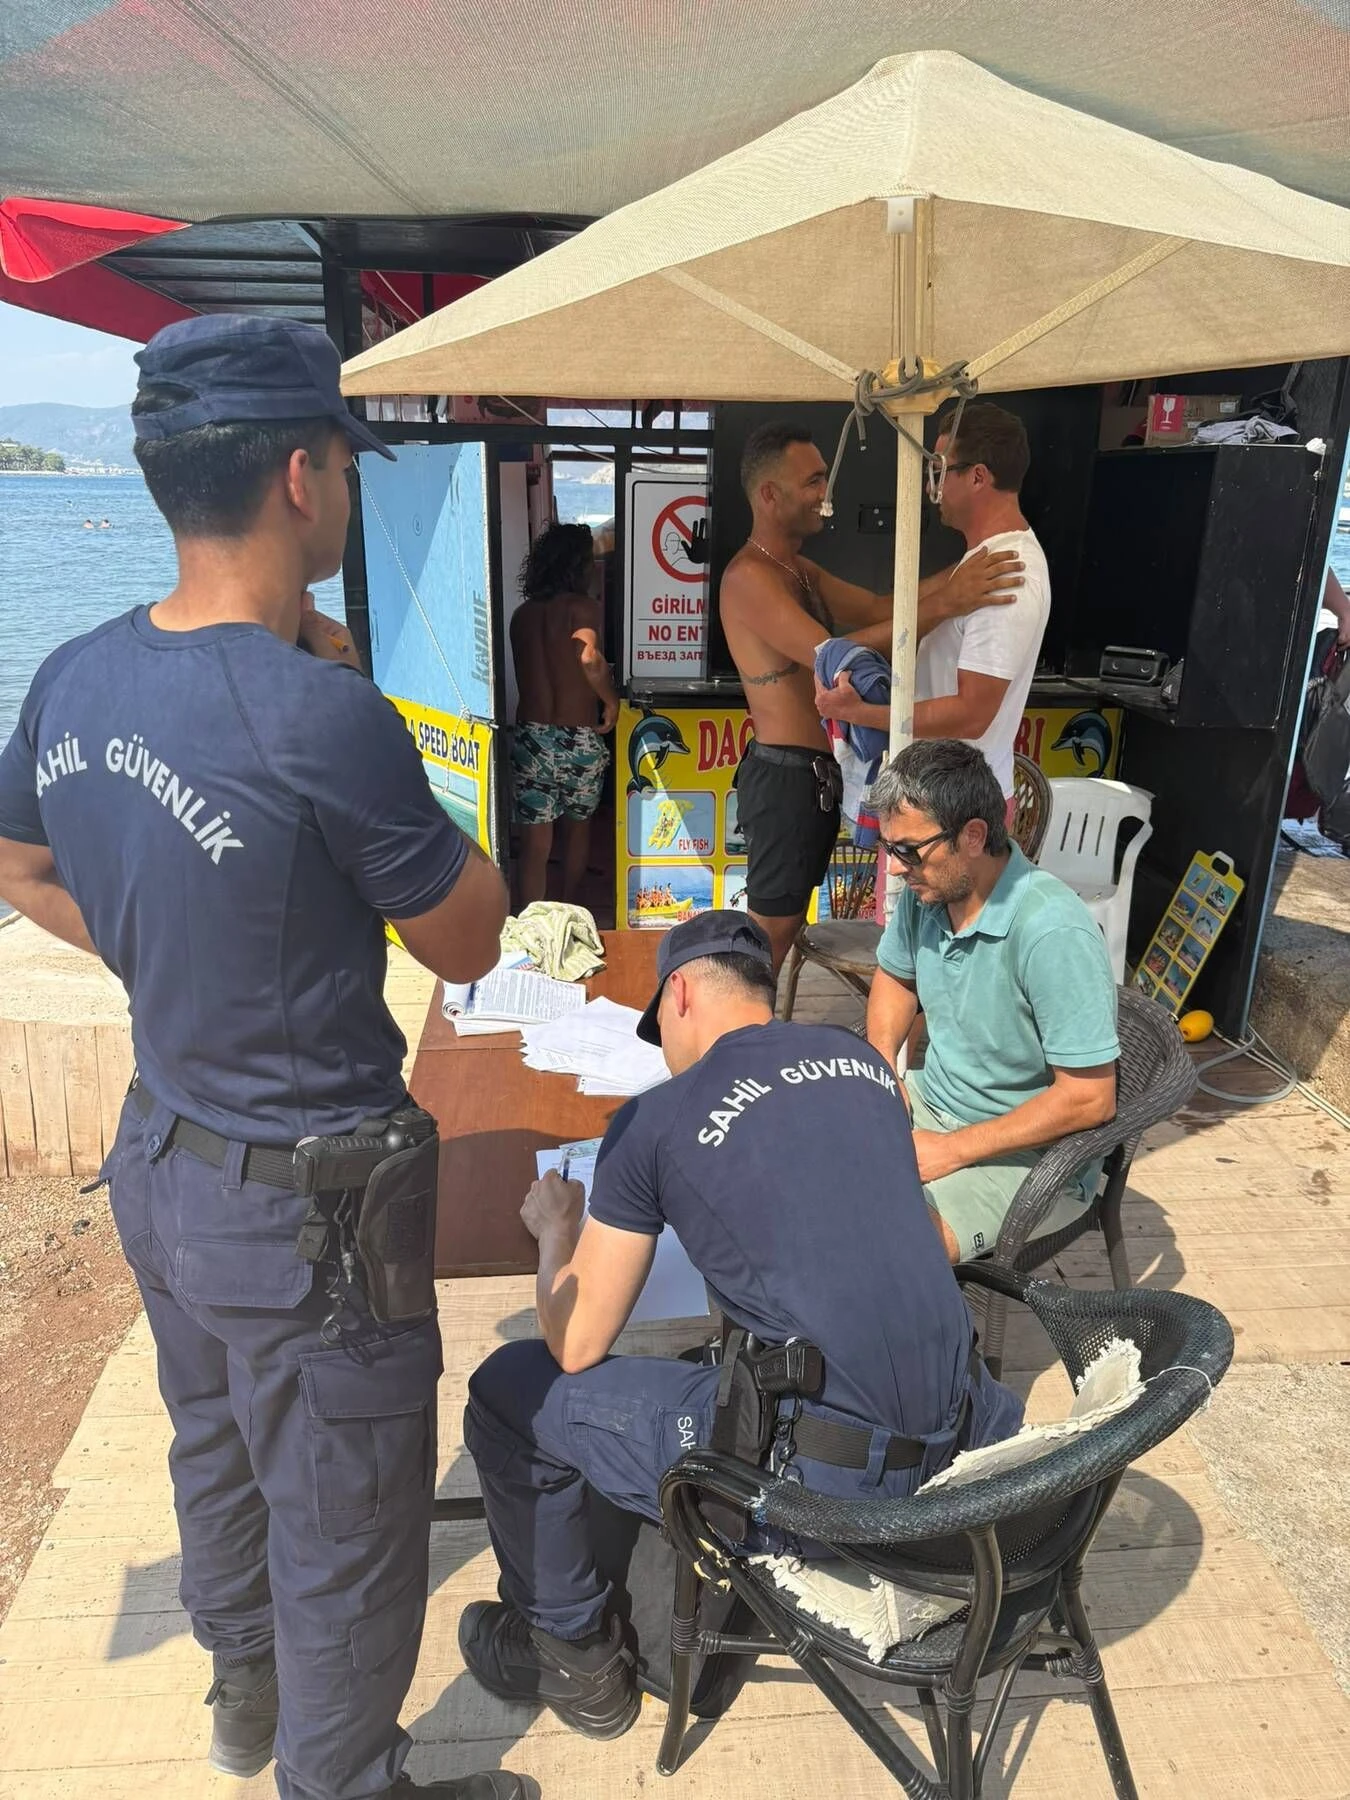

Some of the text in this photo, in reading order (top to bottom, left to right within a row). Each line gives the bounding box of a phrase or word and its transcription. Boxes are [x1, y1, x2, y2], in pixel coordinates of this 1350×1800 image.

[648, 625, 672, 641] NO
[637, 651, 677, 661] ВЪЕЗД
[418, 721, 449, 759] SPEED
[451, 734, 480, 772] BOAT
[105, 733, 245, 865] GÜVENLİK
[678, 839, 709, 851] FLY FISH
[698, 1057, 897, 1147] SAHİL GÜVENLİK
